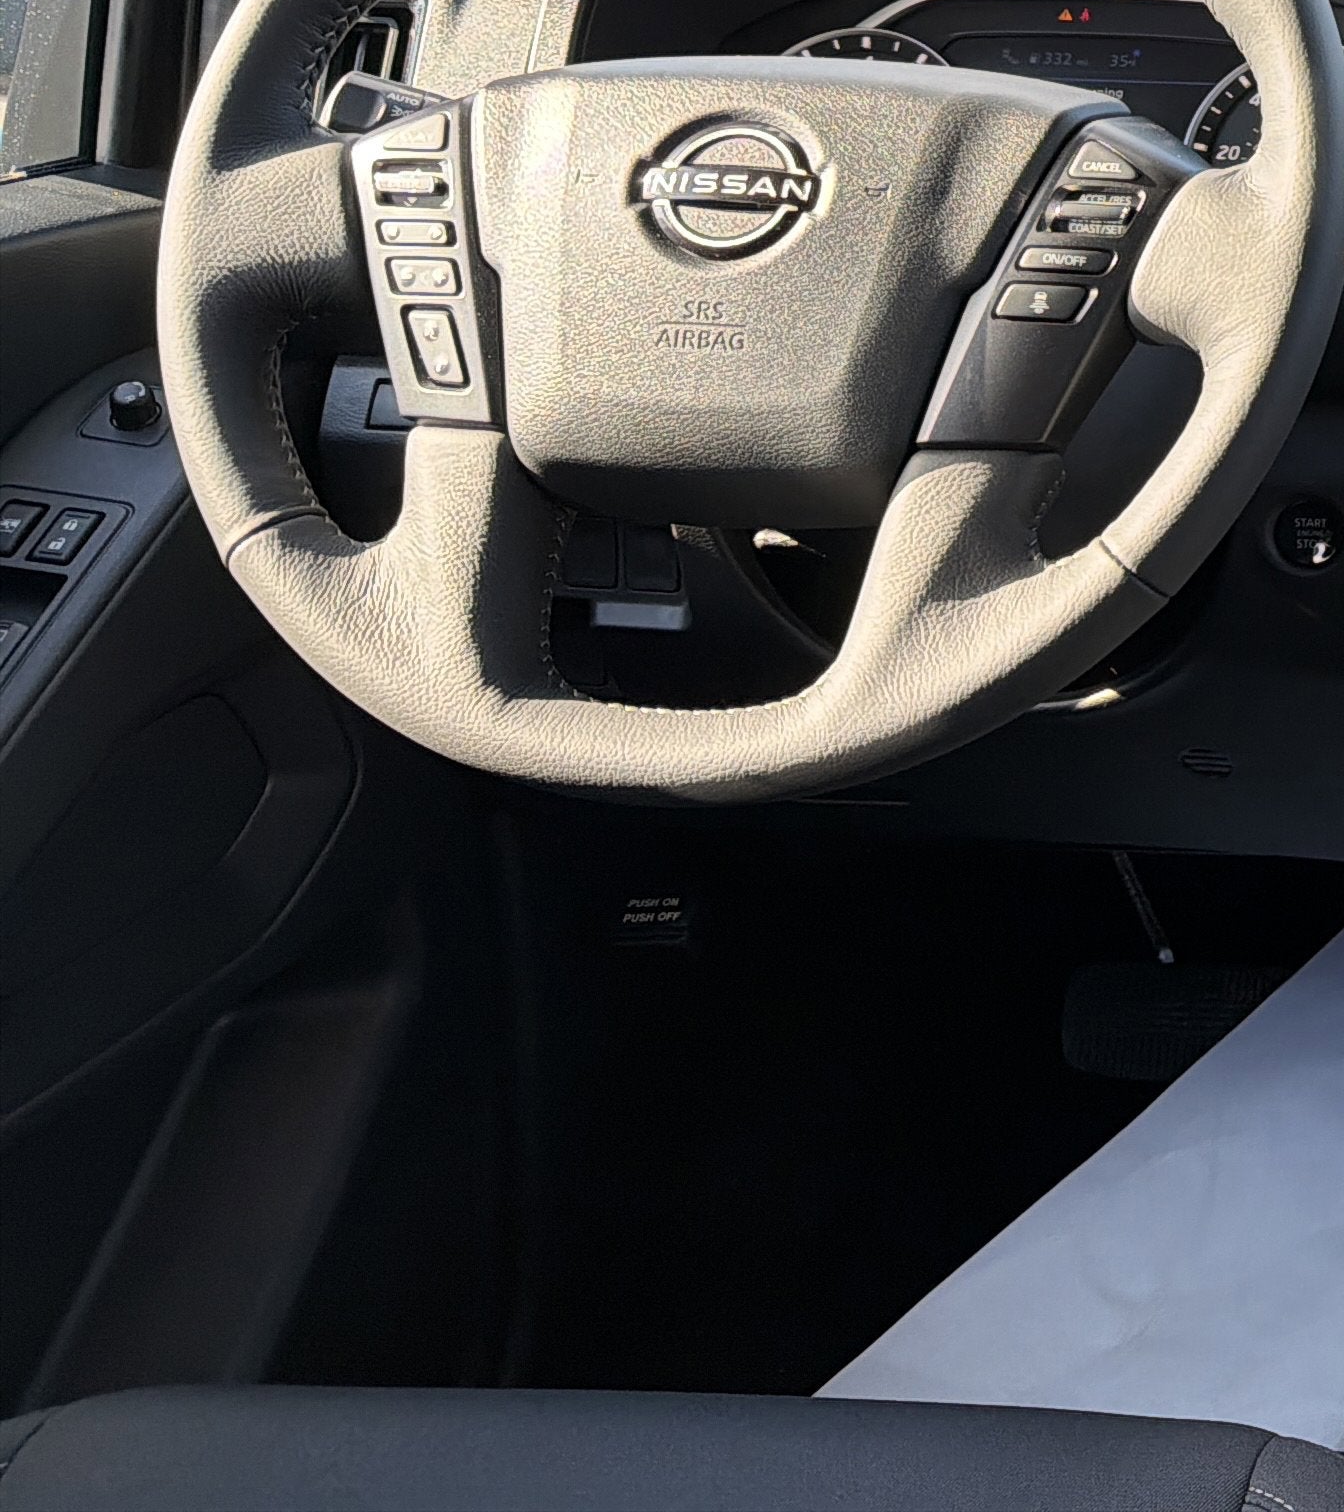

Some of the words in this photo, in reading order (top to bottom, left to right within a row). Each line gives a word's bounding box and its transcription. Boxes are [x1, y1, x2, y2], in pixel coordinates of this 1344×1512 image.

[386, 92, 420, 106] AUTO
[1216, 145, 1241, 161] 20
[1082, 162, 1123, 174] CANCEL
[650, 172, 812, 202] NISSAN
[1068, 222, 1125, 235] COAST/SET
[1042, 253, 1088, 268] ON/OFF
[682, 300, 725, 321] SRS
[655, 328, 745, 352] AIRBAG
[1294, 518, 1327, 528] START
[1296, 538, 1326, 549] STO
[627, 898, 660, 908] PUSH
[662, 897, 680, 907] ON
[622, 912, 655, 924] PUSH
[657, 911, 682, 922] OFF
